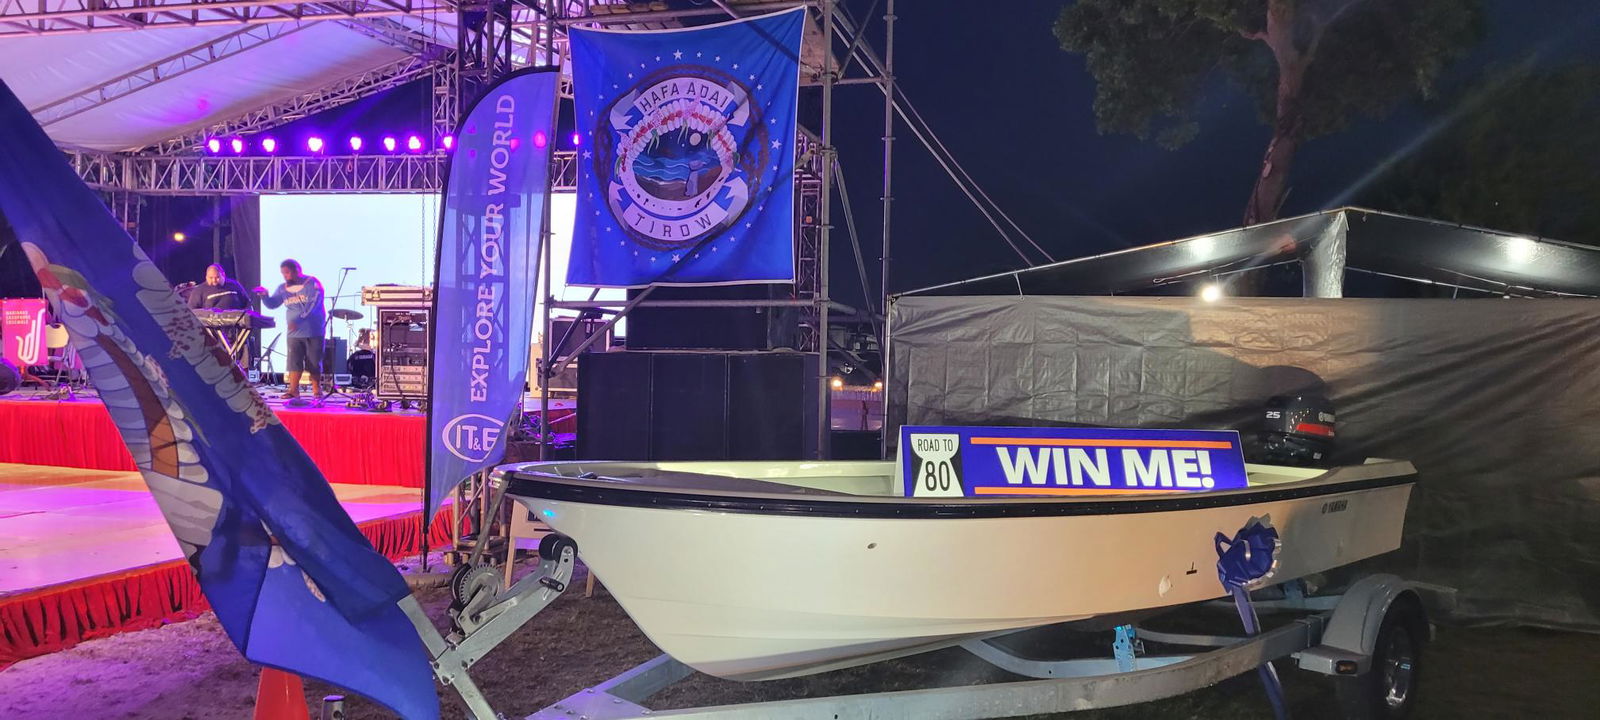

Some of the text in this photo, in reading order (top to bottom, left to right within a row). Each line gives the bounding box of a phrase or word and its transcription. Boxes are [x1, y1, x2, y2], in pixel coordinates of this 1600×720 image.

[639, 82, 680, 112] HAFA
[634, 213, 712, 237] TIROW
[470, 94, 516, 403] EXPLORE YOUR WORLD
[1265, 410, 1281, 419] 25
[455, 424, 501, 451] IT&E
[917, 439, 954, 452] ROAD TO
[925, 460, 950, 492] 80
[995, 446, 1215, 489] WIN ME!
